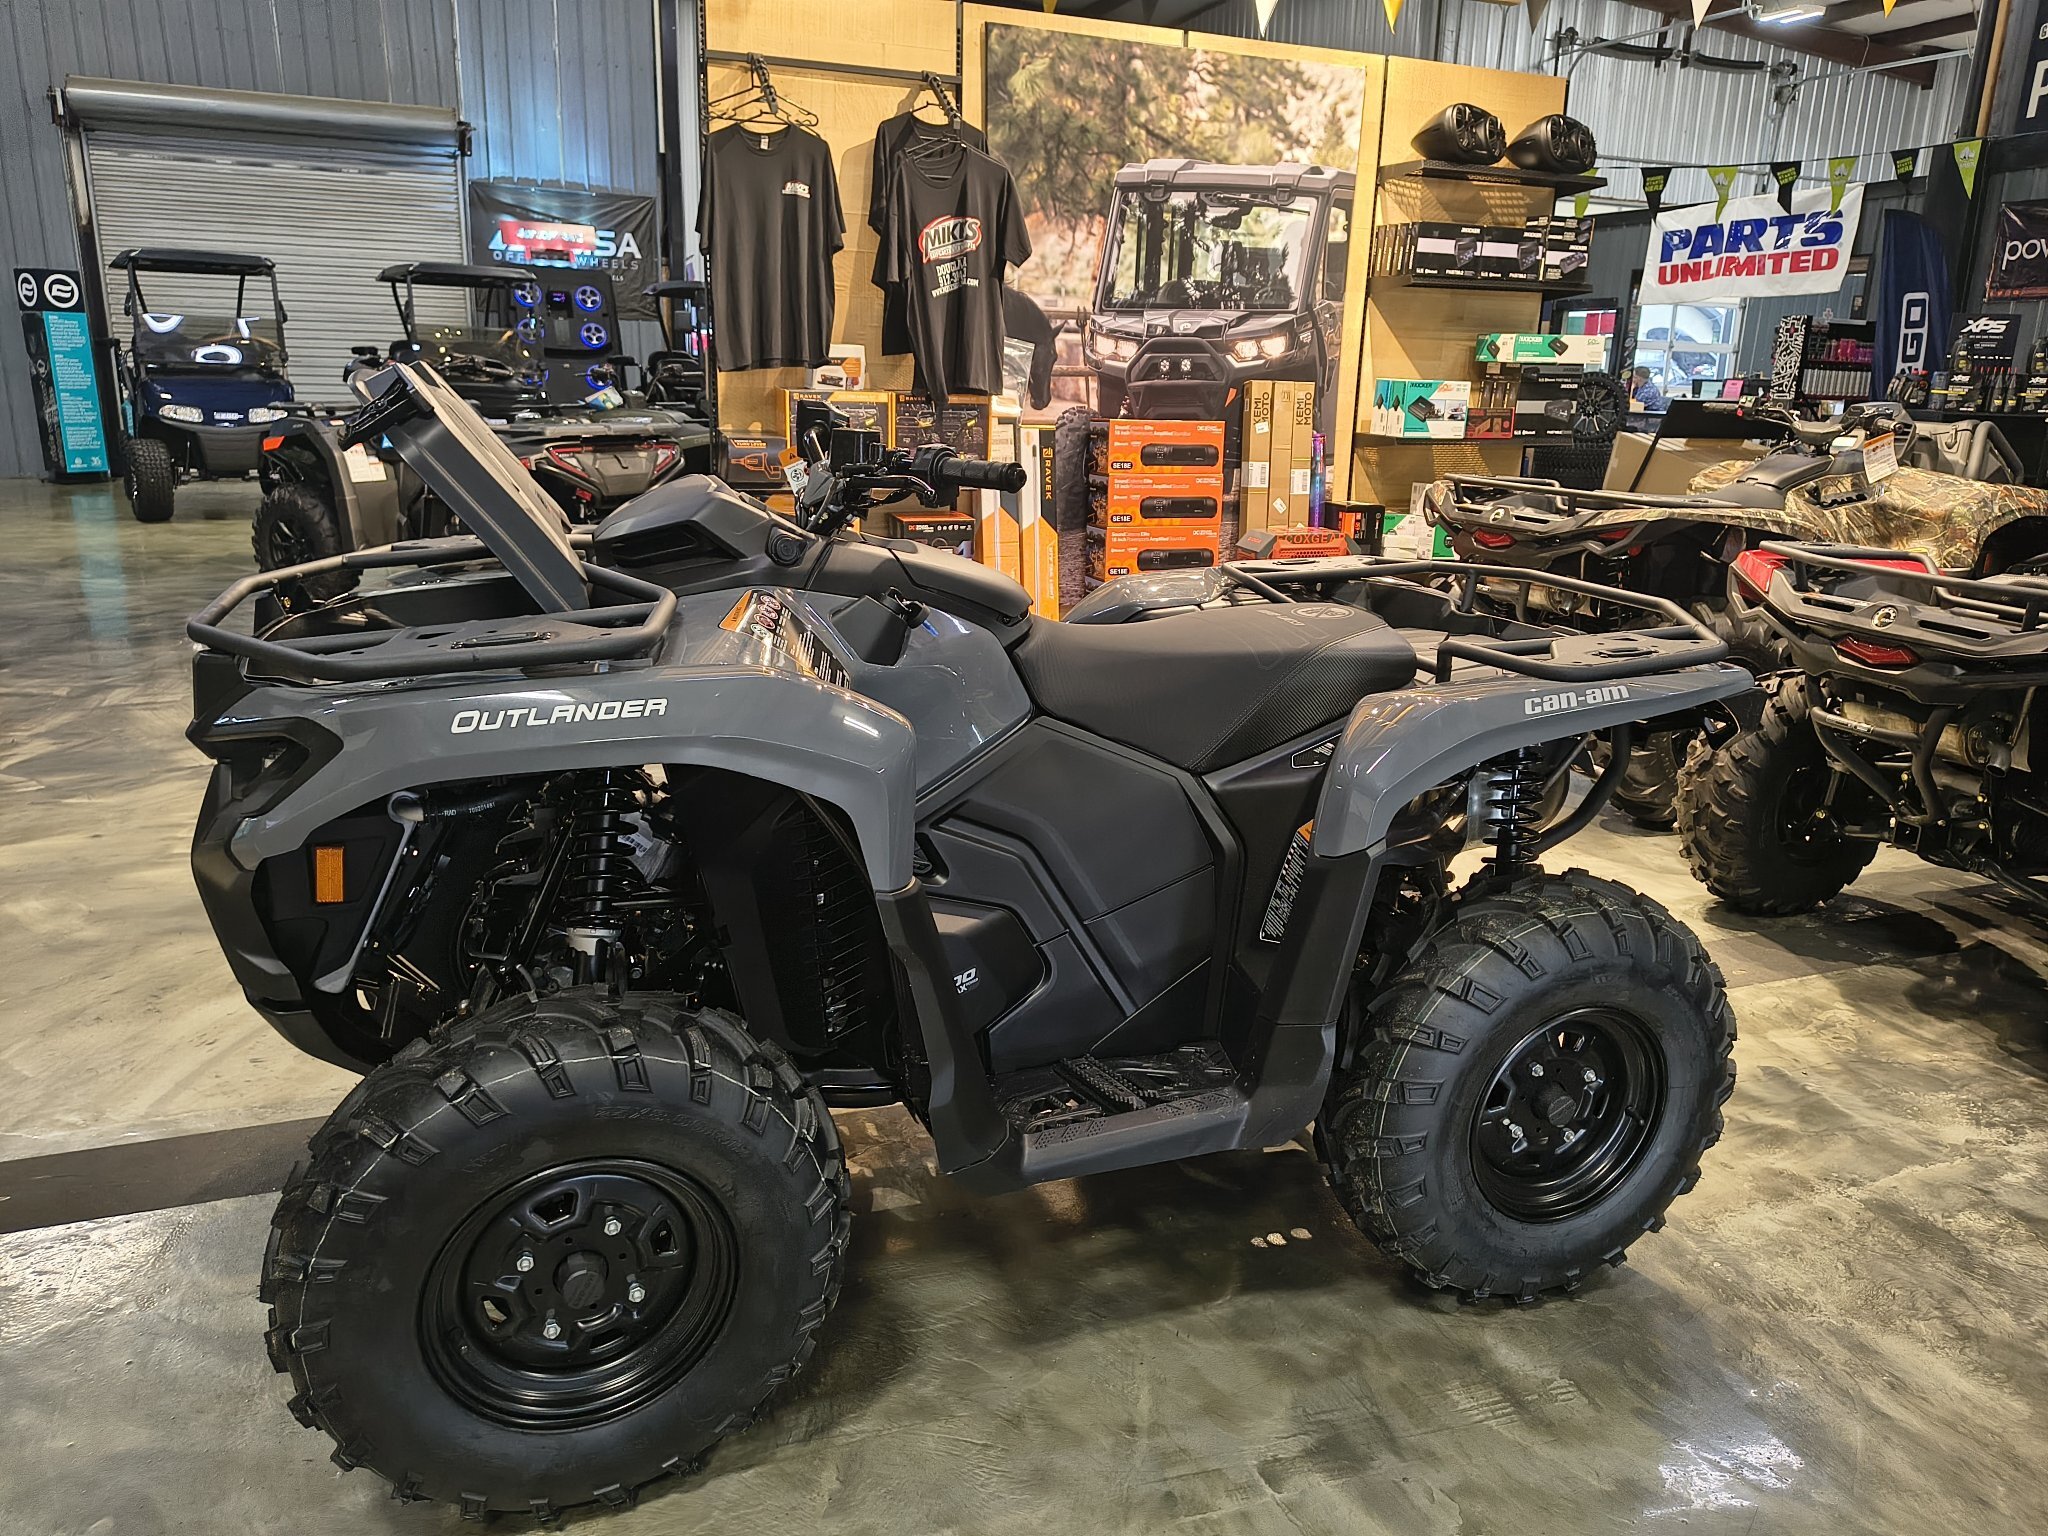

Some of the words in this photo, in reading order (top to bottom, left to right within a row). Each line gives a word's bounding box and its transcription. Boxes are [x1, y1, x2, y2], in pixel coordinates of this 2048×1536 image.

[1660, 209, 1844, 263] PARTS
[576, 255, 639, 270] WHEELS
[1658, 248, 1840, 285] UNLIMITED
[1960, 316, 2011, 333] XPS
[1296, 398, 1304, 425] KEMI
[1304, 392, 1312, 425] MOTO
[1524, 685, 1630, 715] can-am
[450, 698, 668, 734] OUTLANDER
